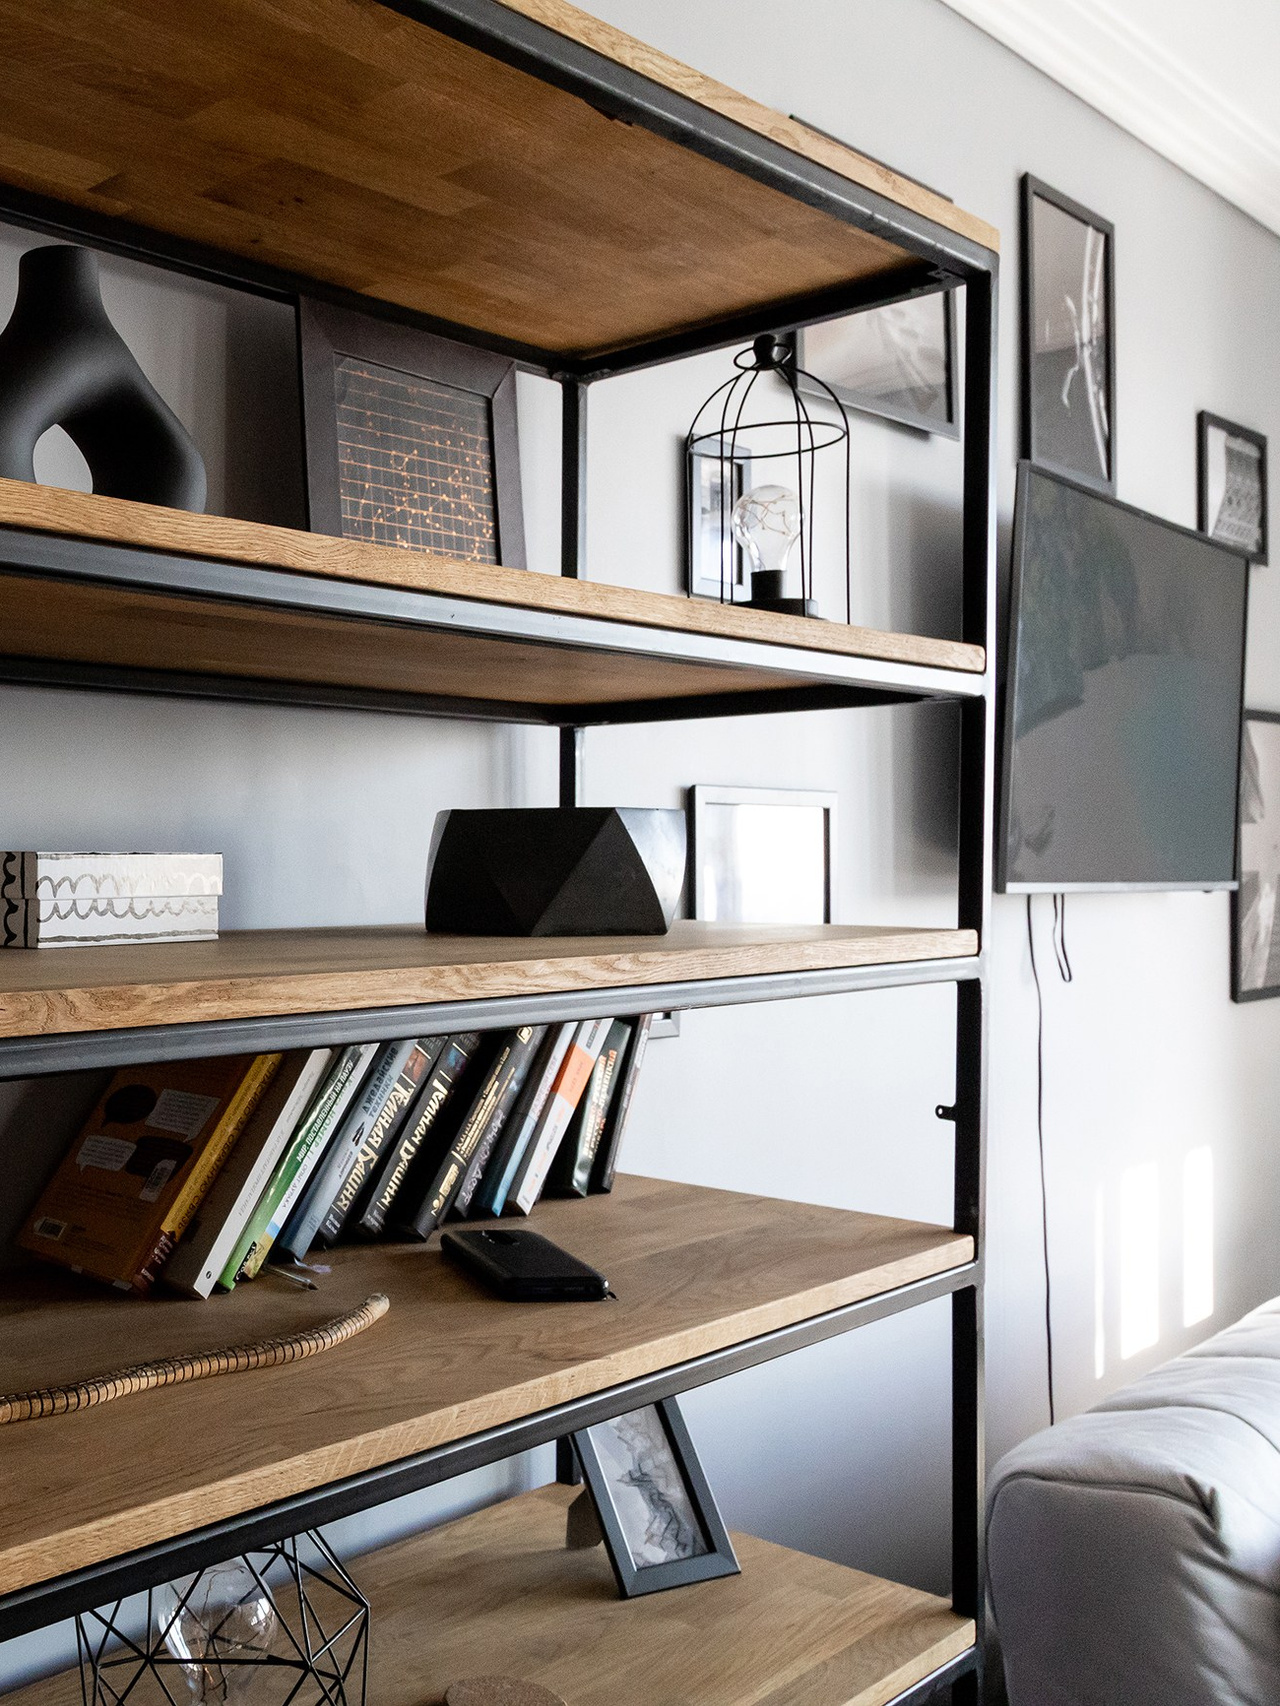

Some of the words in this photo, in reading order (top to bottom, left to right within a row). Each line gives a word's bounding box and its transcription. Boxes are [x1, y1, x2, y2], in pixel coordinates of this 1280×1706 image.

[241, 1061, 278, 1116] СПАСИБО
[304, 1091, 338, 1145] ПОСТАВЛЕННЫЙ
[333, 1081, 343, 1092] НА
[338, 1059, 355, 1082] ПАУЗУ
[314, 1109, 336, 1148] НОМЕР
[196, 1132, 236, 1193] ОБРАТНУЮ
[294, 1163, 308, 1184] ОПЫТ
[175, 1193, 201, 1231] СВЯЗЬ
[280, 1181, 298, 1209] ДУРАКА
